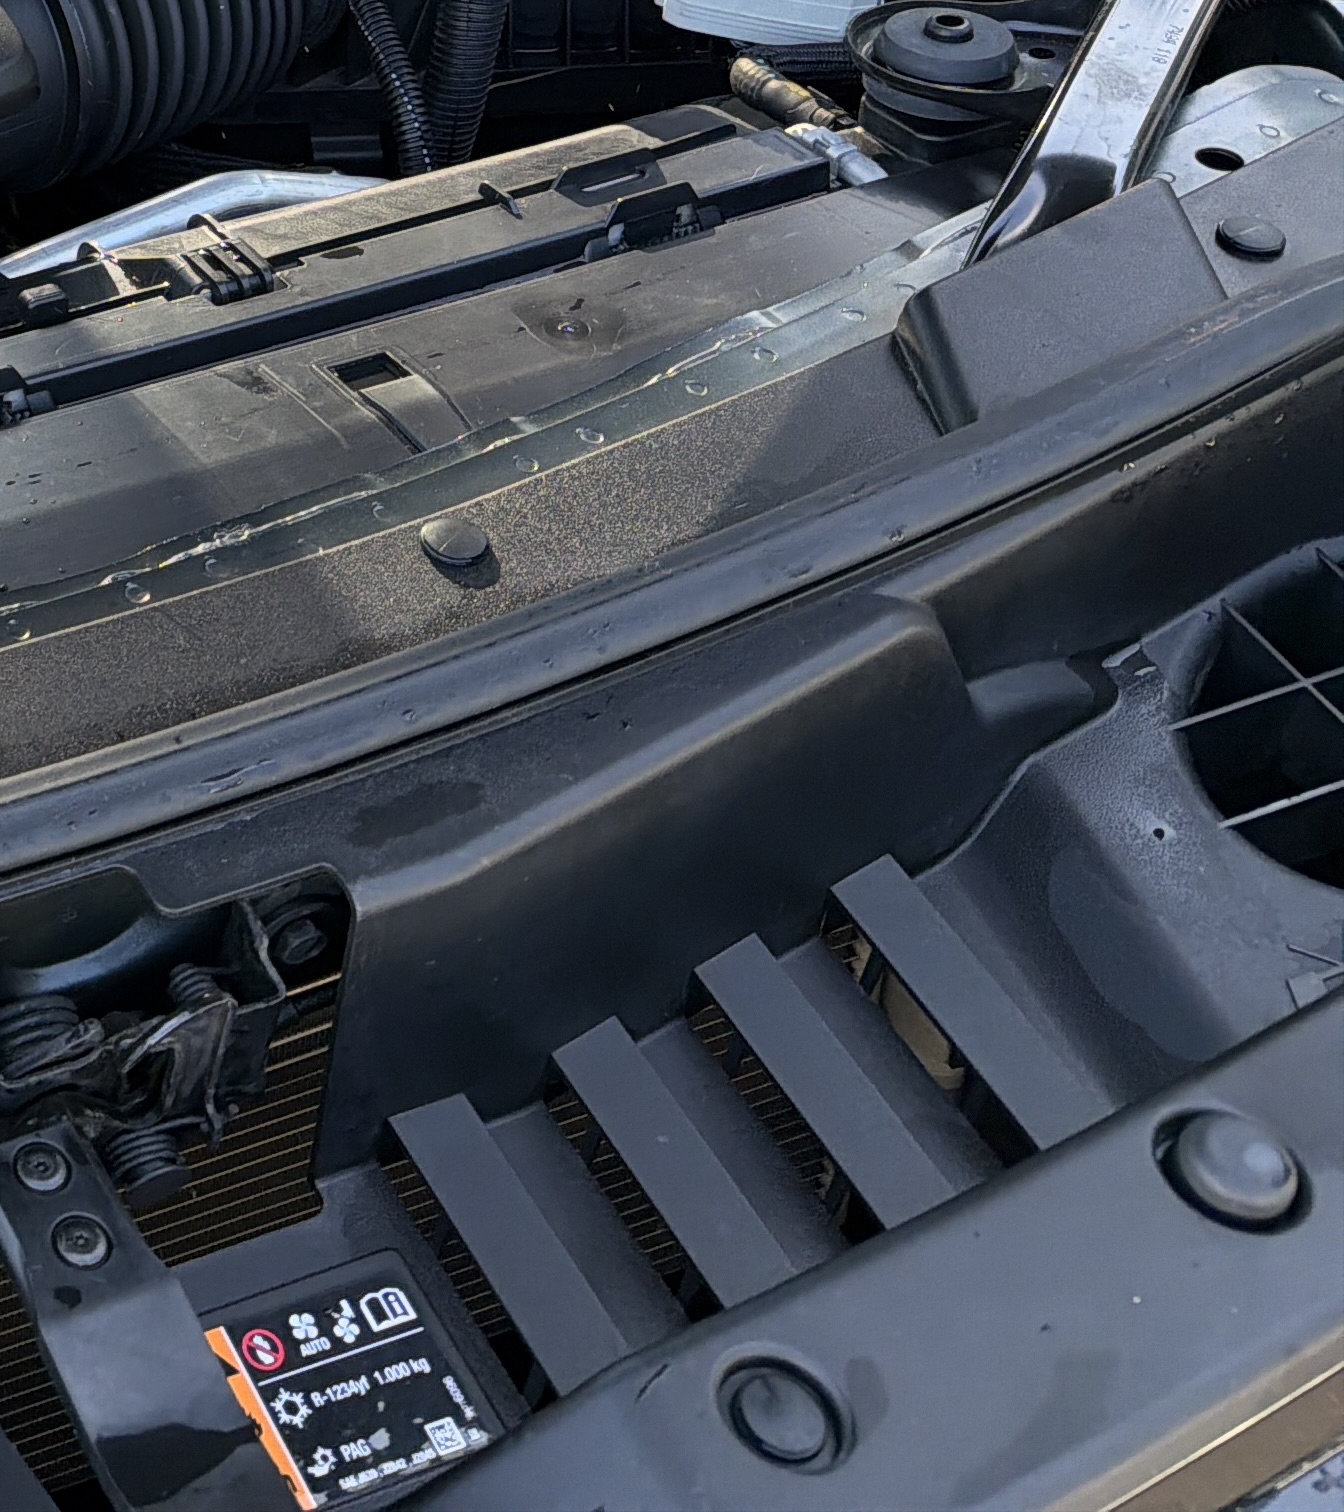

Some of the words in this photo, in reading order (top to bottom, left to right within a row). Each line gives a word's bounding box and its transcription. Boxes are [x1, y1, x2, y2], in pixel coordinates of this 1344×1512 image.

[300, 1336, 331, 1357] AUTO
[311, 1375, 371, 1408] R-1234yf
[373, 1361, 412, 1385] 1.000
[409, 1357, 431, 1374] kg
[339, 1439, 372, 1462] PAG
